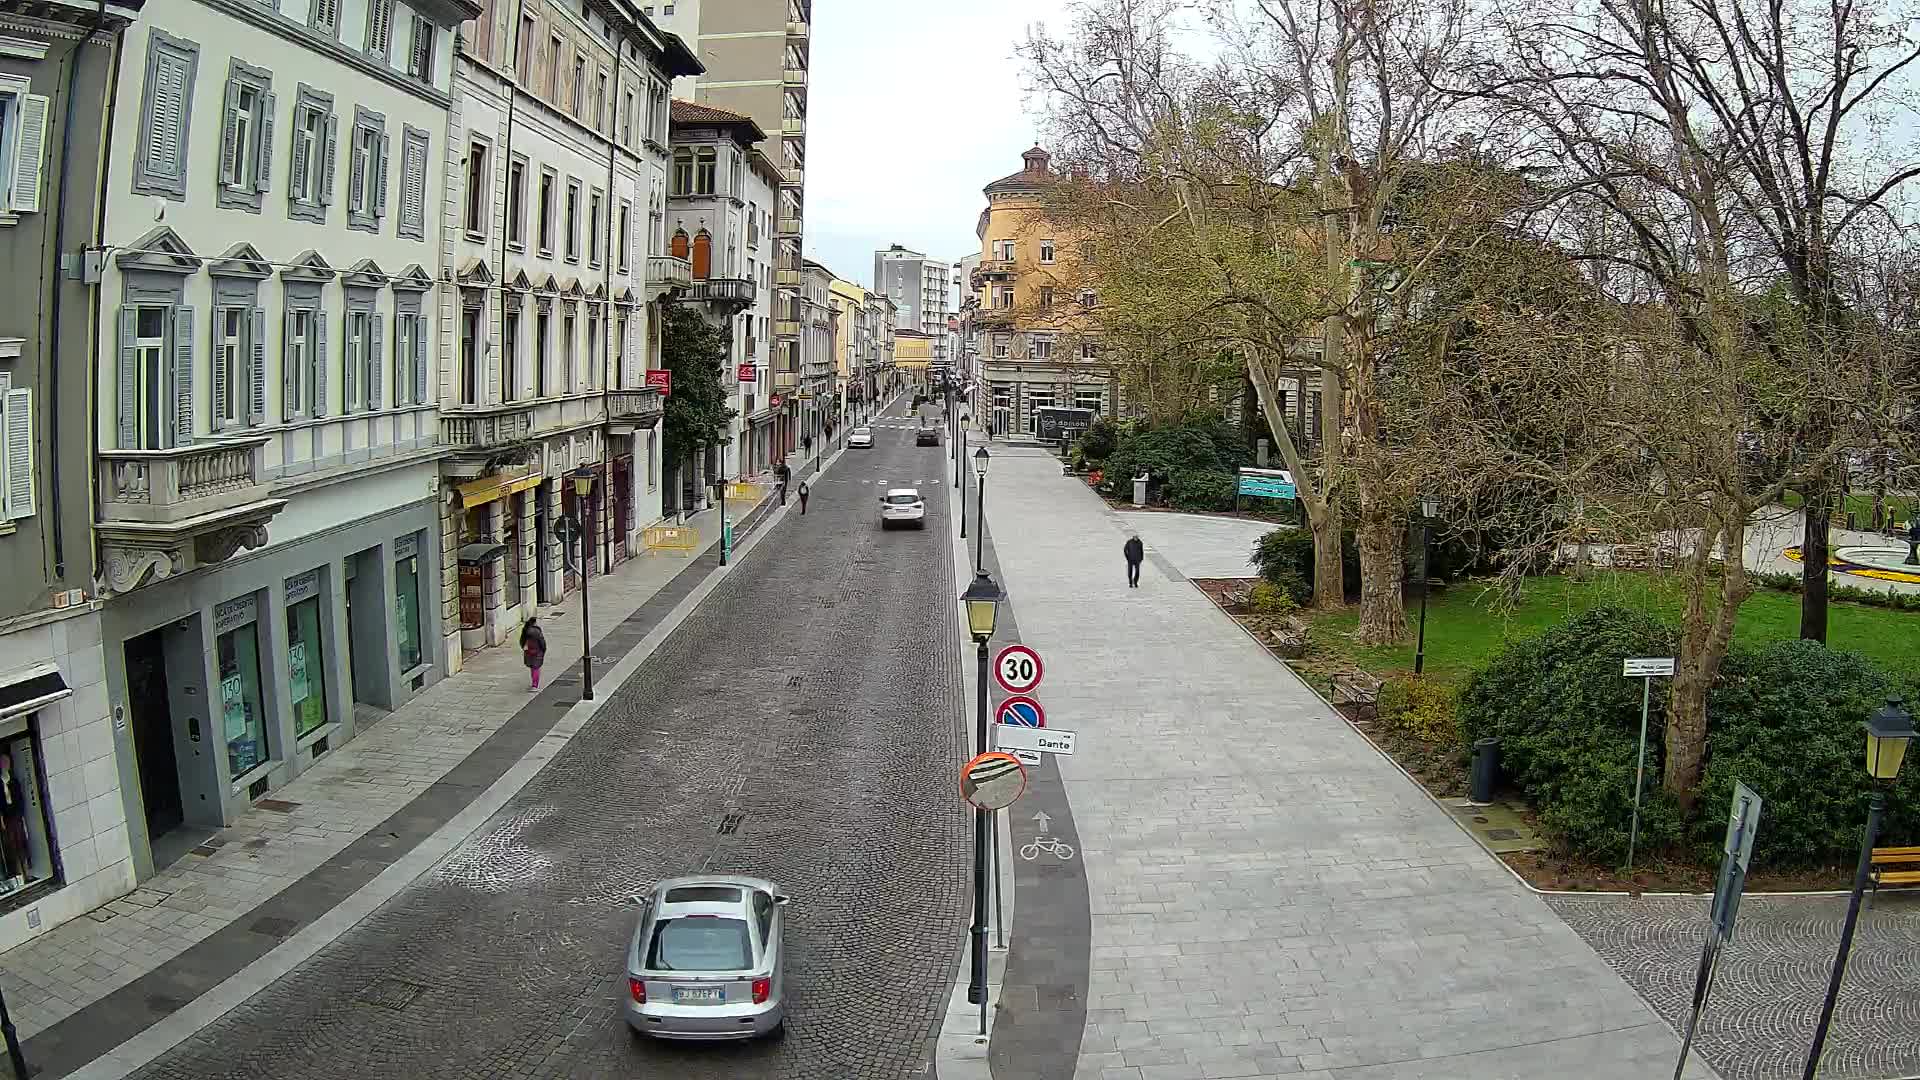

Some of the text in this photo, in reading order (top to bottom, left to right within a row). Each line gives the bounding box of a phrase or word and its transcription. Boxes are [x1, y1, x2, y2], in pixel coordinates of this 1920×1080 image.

[1005, 658, 1033, 681] 30
[222, 677, 241, 700] 130
[1038, 738, 1070, 750] Dante
